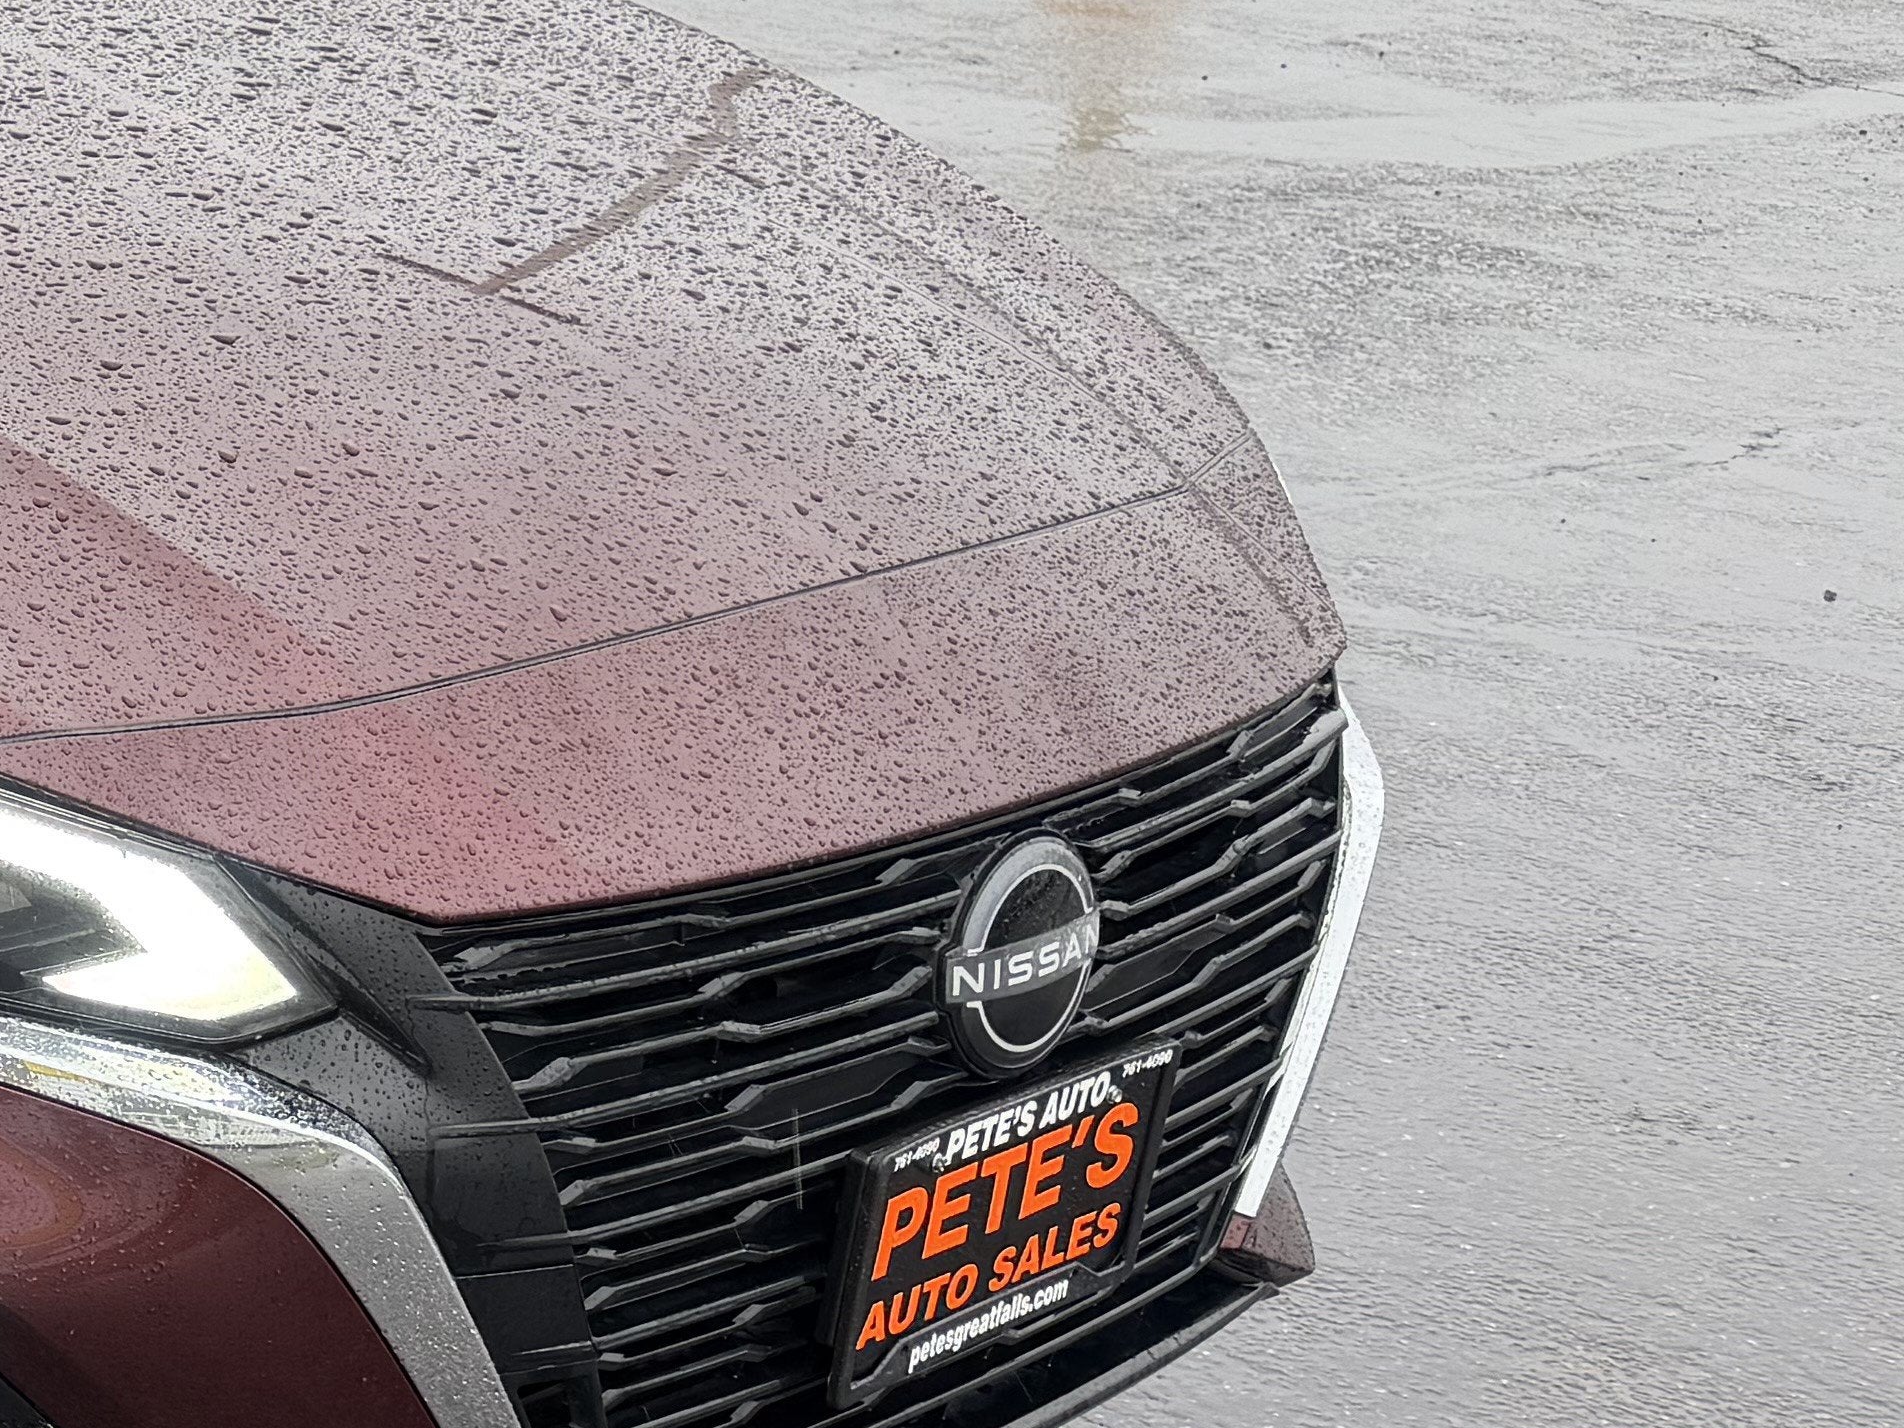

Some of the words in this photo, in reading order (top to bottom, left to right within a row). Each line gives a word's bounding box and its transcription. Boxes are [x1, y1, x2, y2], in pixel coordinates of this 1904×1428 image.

[951, 923, 1100, 996] NISSAN
[1124, 1049, 1173, 1078] 761-4090
[945, 1100, 1038, 1166] PETE'S
[1041, 1071, 1111, 1129] AUTO
[871, 1102, 1139, 1282] PETE'S
[855, 1263, 979, 1350] AUTO
[988, 1202, 1122, 1292] SALES
[907, 1278, 1070, 1374] petesgreatfalls.com
